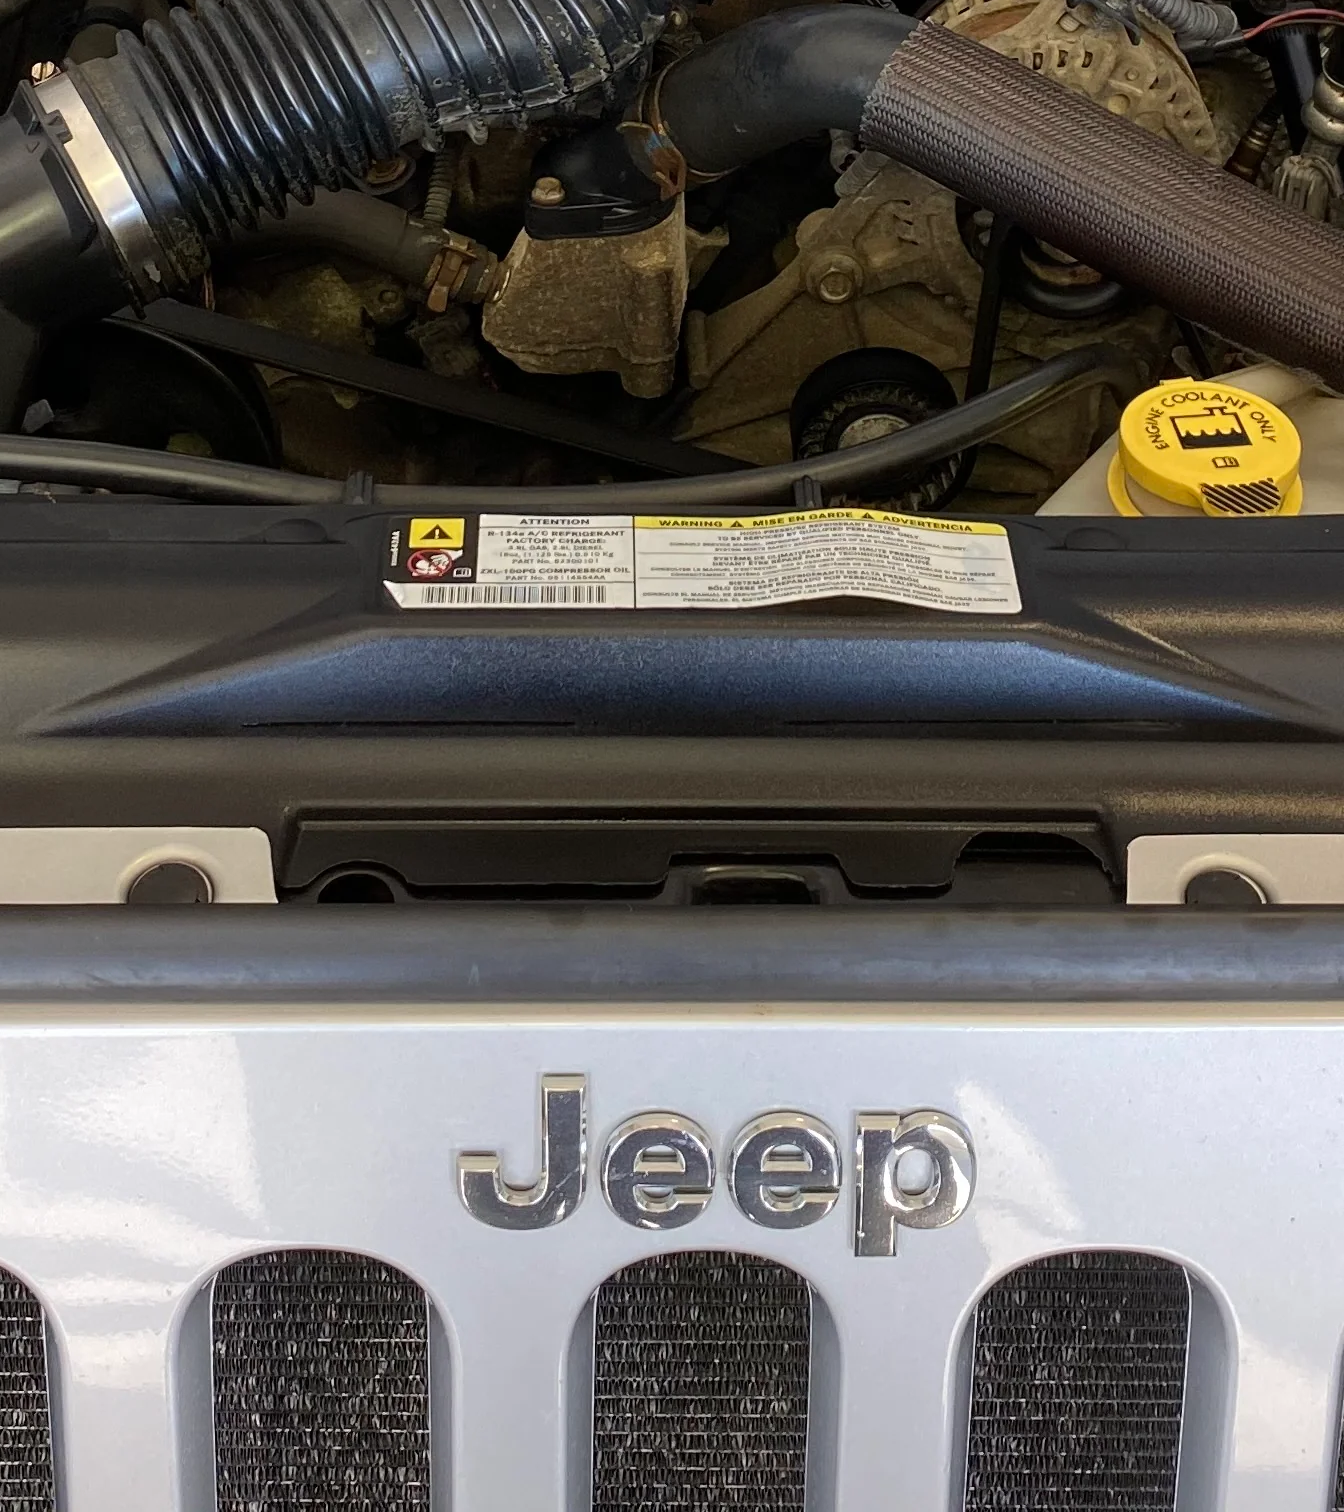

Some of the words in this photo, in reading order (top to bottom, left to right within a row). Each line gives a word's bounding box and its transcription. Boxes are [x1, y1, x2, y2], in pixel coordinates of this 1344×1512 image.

[1144, 407, 1170, 451] ENGINE
[1161, 391, 1250, 410] COOLANT
[1250, 411, 1277, 444] ONLY
[752, 517, 784, 526] MISE
[788, 515, 805, 523] EN
[809, 511, 853, 520] GARDE
[882, 515, 973, 532] ADVERTENCIA
[455, 1072, 977, 1257] Jeep
